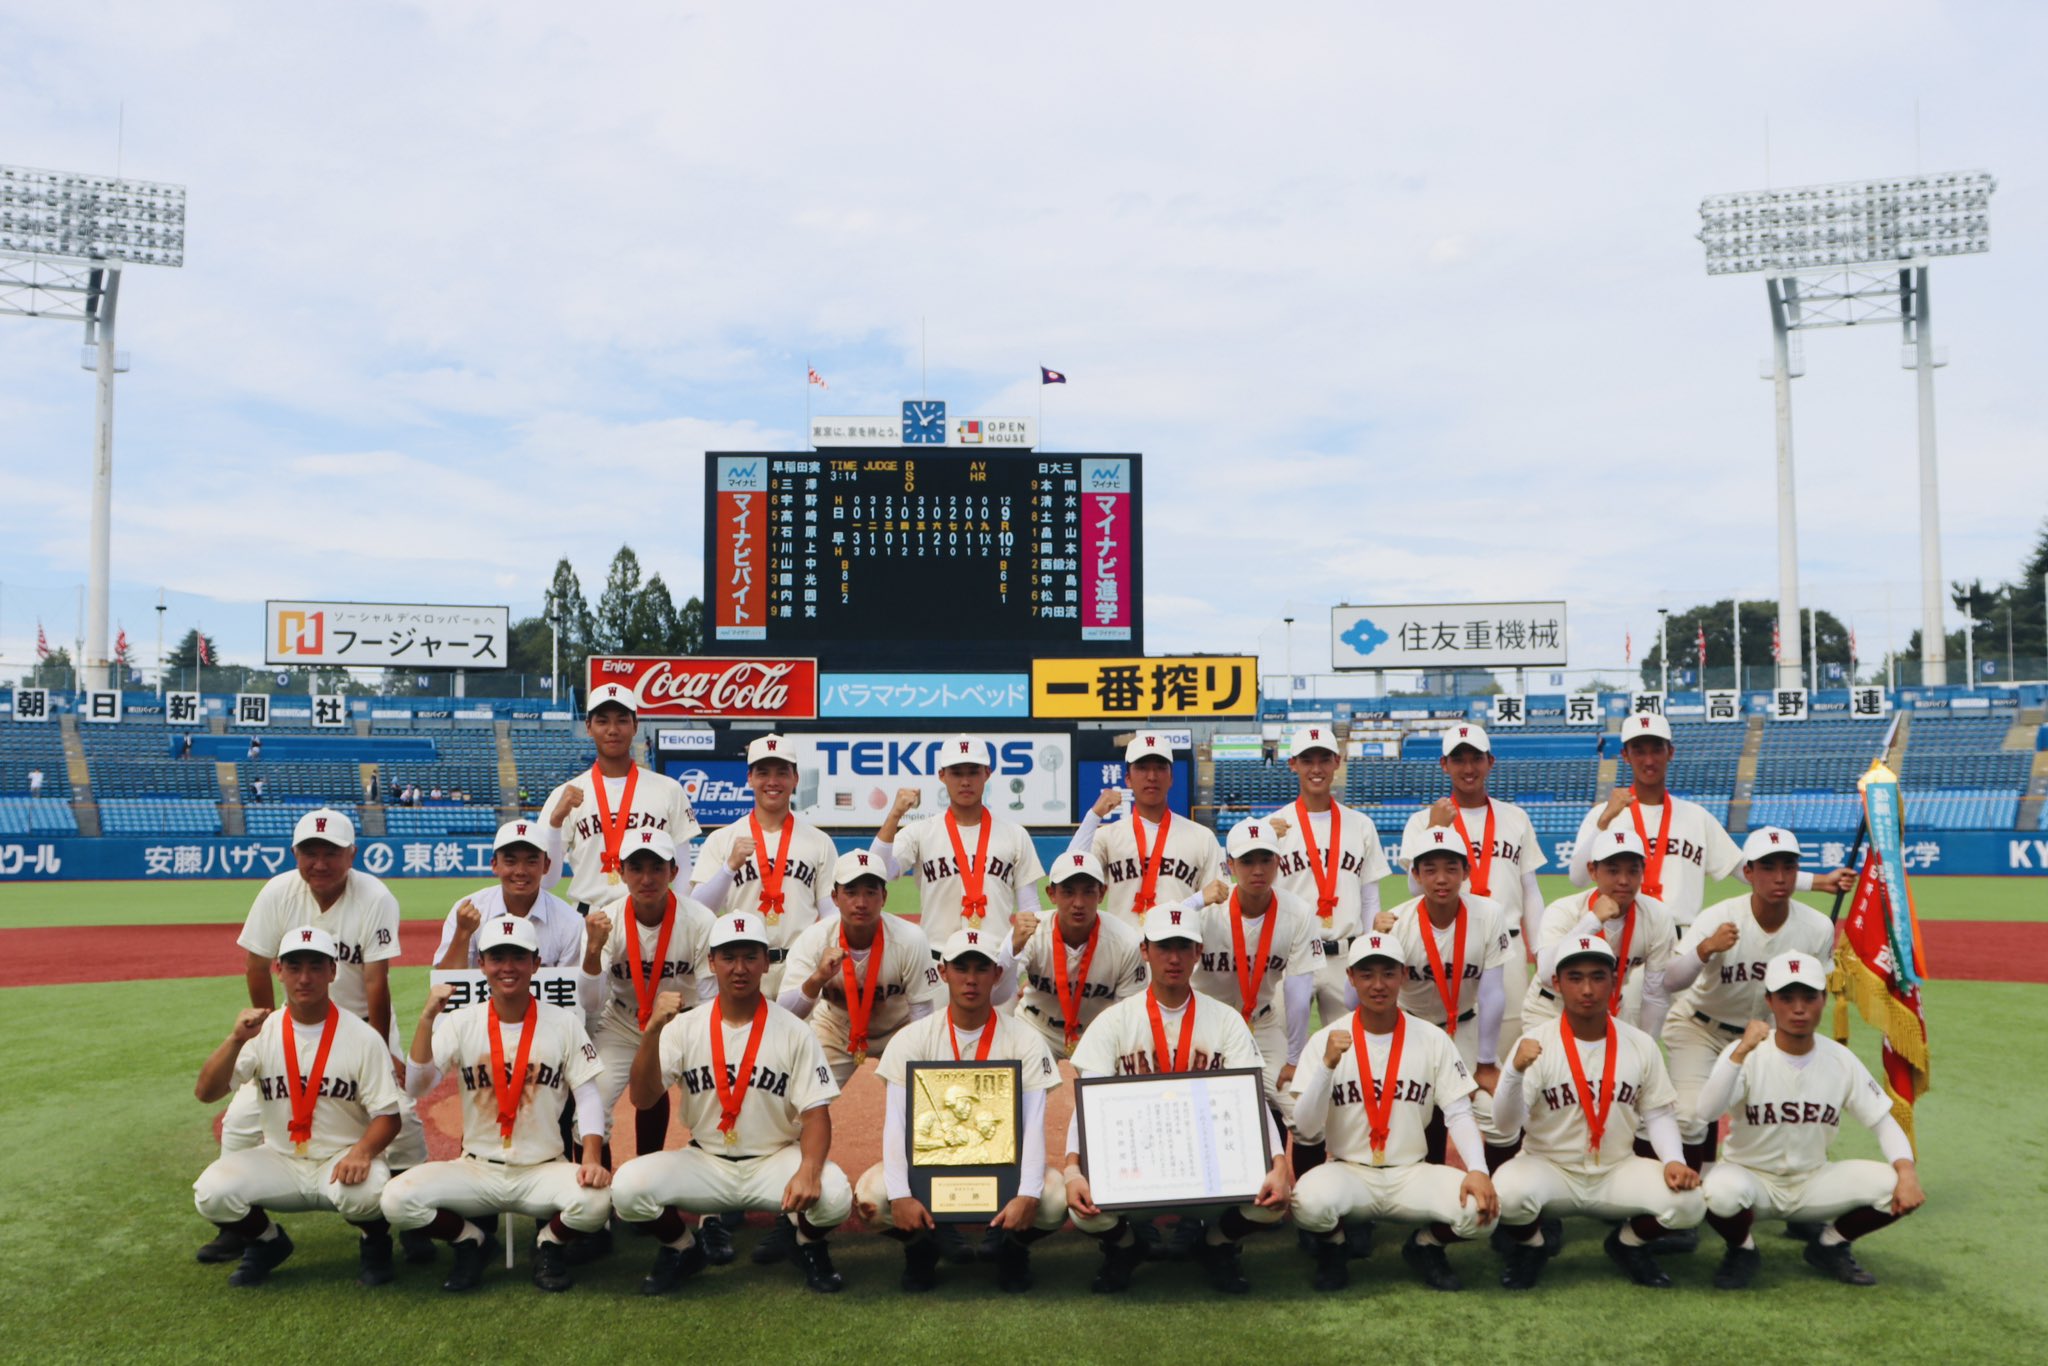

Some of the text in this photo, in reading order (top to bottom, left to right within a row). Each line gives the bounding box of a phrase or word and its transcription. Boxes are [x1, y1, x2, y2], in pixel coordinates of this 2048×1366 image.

[988, 422, 1025, 432] OPEN
[988, 433, 1025, 443] HOUSE
[772, 461, 821, 474] 早稲田実
[830, 461, 897, 471] TIME JUDGE
[905, 461, 914, 472] B
[970, 462, 986, 471] AV
[1038, 463, 1074, 474] 日大三
[830, 471, 858, 481] 3:14
[905, 471, 914, 482] S
[970, 472, 986, 481] HR
[771, 480, 778, 489] 8
[1031, 480, 1077, 492] 9 本間
[1092, 481, 1120, 489] マイナビ
[771, 496, 778, 505] 6
[835, 496, 843, 505] H
[1031, 497, 1038, 505] 4
[771, 511, 778, 521] 5
[833, 507, 844, 519] 日
[853, 507, 861, 520] 0
[884, 507, 893, 520] 3
[900, 507, 909, 520] 0
[917, 507, 925, 520] 3
[933, 507, 942, 520] 0
[949, 507, 957, 520] 2
[964, 507, 973, 520] 0
[980, 507, 989, 520] 0
[1000, 506, 1011, 521] 9
[1031, 511, 1077, 524] 8 土井
[772, 527, 778, 536] 7
[831, 532, 846, 546] 早
[852, 532, 861, 545] 3
[884, 532, 893, 545] 0
[933, 533, 941, 546] 2
[949, 533, 957, 546] 0
[978, 533, 992, 545] 1X
[998, 532, 1014, 547] 10
[780, 542, 817, 554] 川上
[834, 548, 842, 556] H
[1031, 543, 1077, 555] 3 岡本
[731, 494, 752, 624] マイナビバイト
[771, 558, 817, 570] 2 山中
[1032, 559, 1038, 569] 2
[1095, 496, 1119, 625] マイナビ進学
[841, 561, 849, 570] B
[999, 561, 1007, 571] B
[771, 575, 778, 584] 3
[841, 571, 849, 581] 8
[1000, 571, 1007, 581] 6
[1031, 575, 1038, 585] 5
[841, 583, 848, 593] E
[999, 584, 1007, 593] E
[771, 591, 777, 599] 4
[842, 593, 849, 604] 2
[1031, 590, 1078, 603] 6 松岡
[1032, 607, 1038, 616] 7
[1398, 619, 1560, 651] 住友重機械
[333, 627, 497, 659] フージャース
[602, 660, 635, 674] Enjoy
[1983, 662, 1995, 674] G
[418, 677, 429, 687] N
[540, 678, 552, 688] M
[633, 661, 796, 709] Coca-Cola
[1046, 664, 1243, 711] 一番搾り
[607, 686, 617, 696] W
[823, 683, 1027, 709] パラマウントベッド
[1640, 718, 1649, 728] W
[1310, 730, 1319, 740] W
[1459, 727, 1468, 737] W
[660, 735, 713, 744] TEKNOS
[1145, 736, 1155, 746] W
[766, 740, 777, 751] W
[960, 742, 969, 753] W
[816, 741, 1033, 775] TEKS
[316, 818, 327, 832] W
[516, 825, 527, 835] W
[1248, 826, 1258, 838] W
[1434, 832, 1443, 843] W
[1769, 832, 1780, 843] W
[642, 833, 652, 843] W
[1615, 833, 1624, 843] W
[0, 844, 61, 875] クール
[145, 842, 286, 875] 安藤ハザマ
[858, 854, 869, 866] W
[1073, 855, 1084, 866] W
[1170, 911, 1182, 925] W
[503, 922, 514, 935] W
[734, 919, 745, 932] W
[302, 931, 312, 942] W
[967, 932, 978, 944] W
[1370, 937, 1381, 948] W
[1579, 938, 1590, 949] W
[1789, 960, 1800, 973] W
